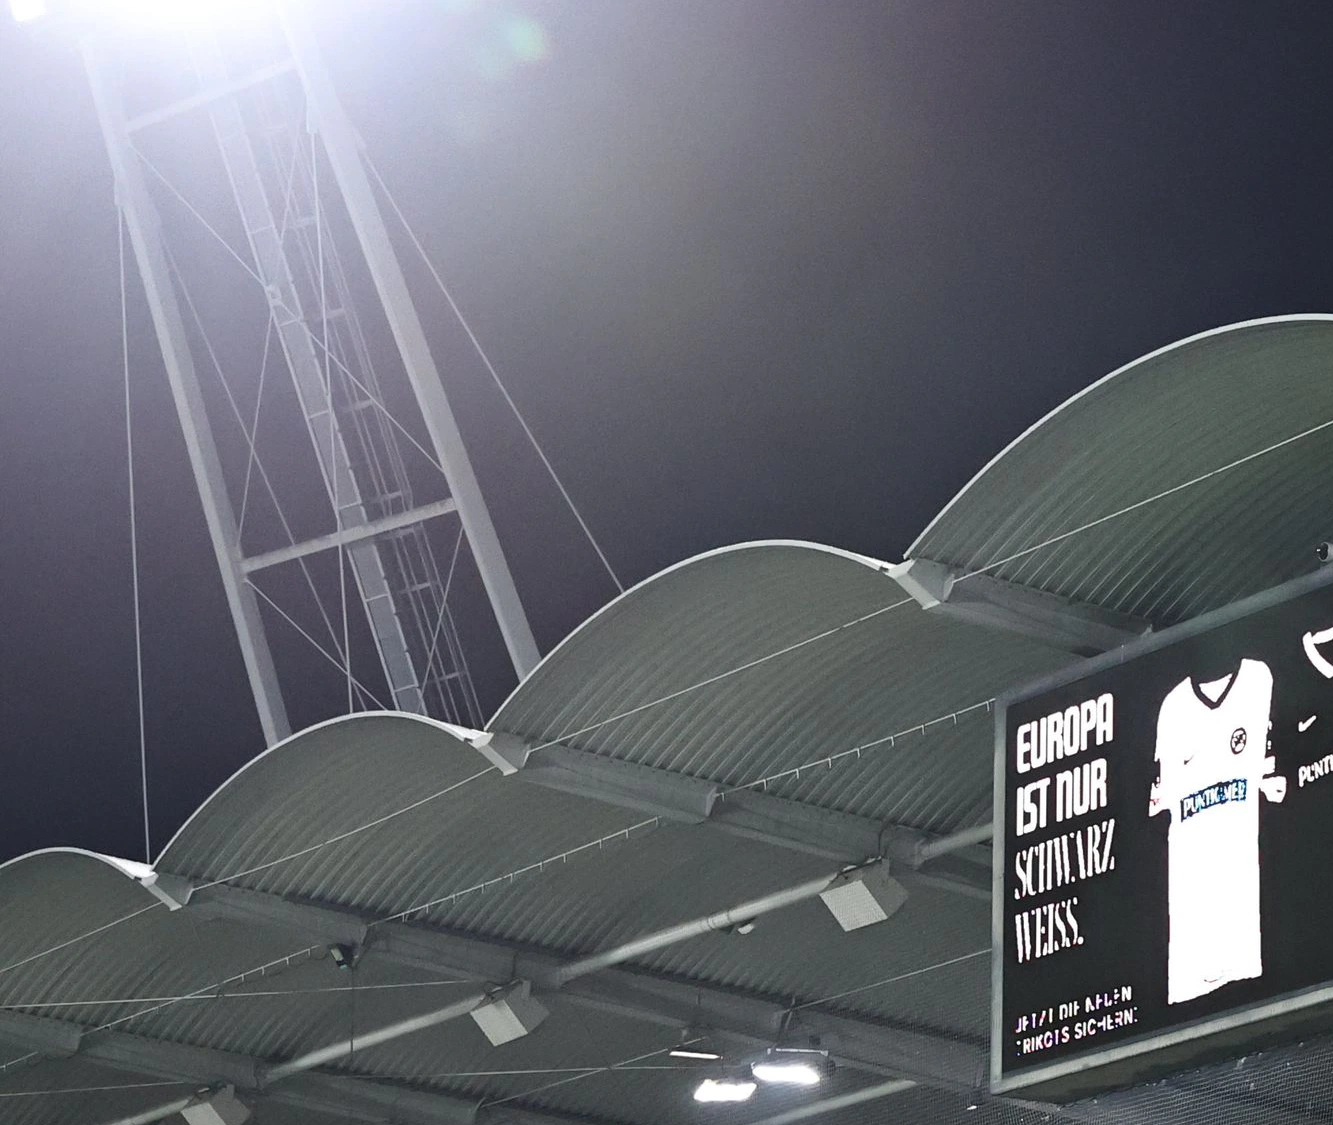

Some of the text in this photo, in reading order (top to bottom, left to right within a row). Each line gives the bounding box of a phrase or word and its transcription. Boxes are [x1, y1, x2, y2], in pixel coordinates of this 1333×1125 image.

[1017, 693, 1113, 773] EUROPA
[1016, 758, 1107, 836] IST NUR
[1015, 819, 1115, 900] SCHWARZ
[1015, 897, 1084, 963] WEISS.
